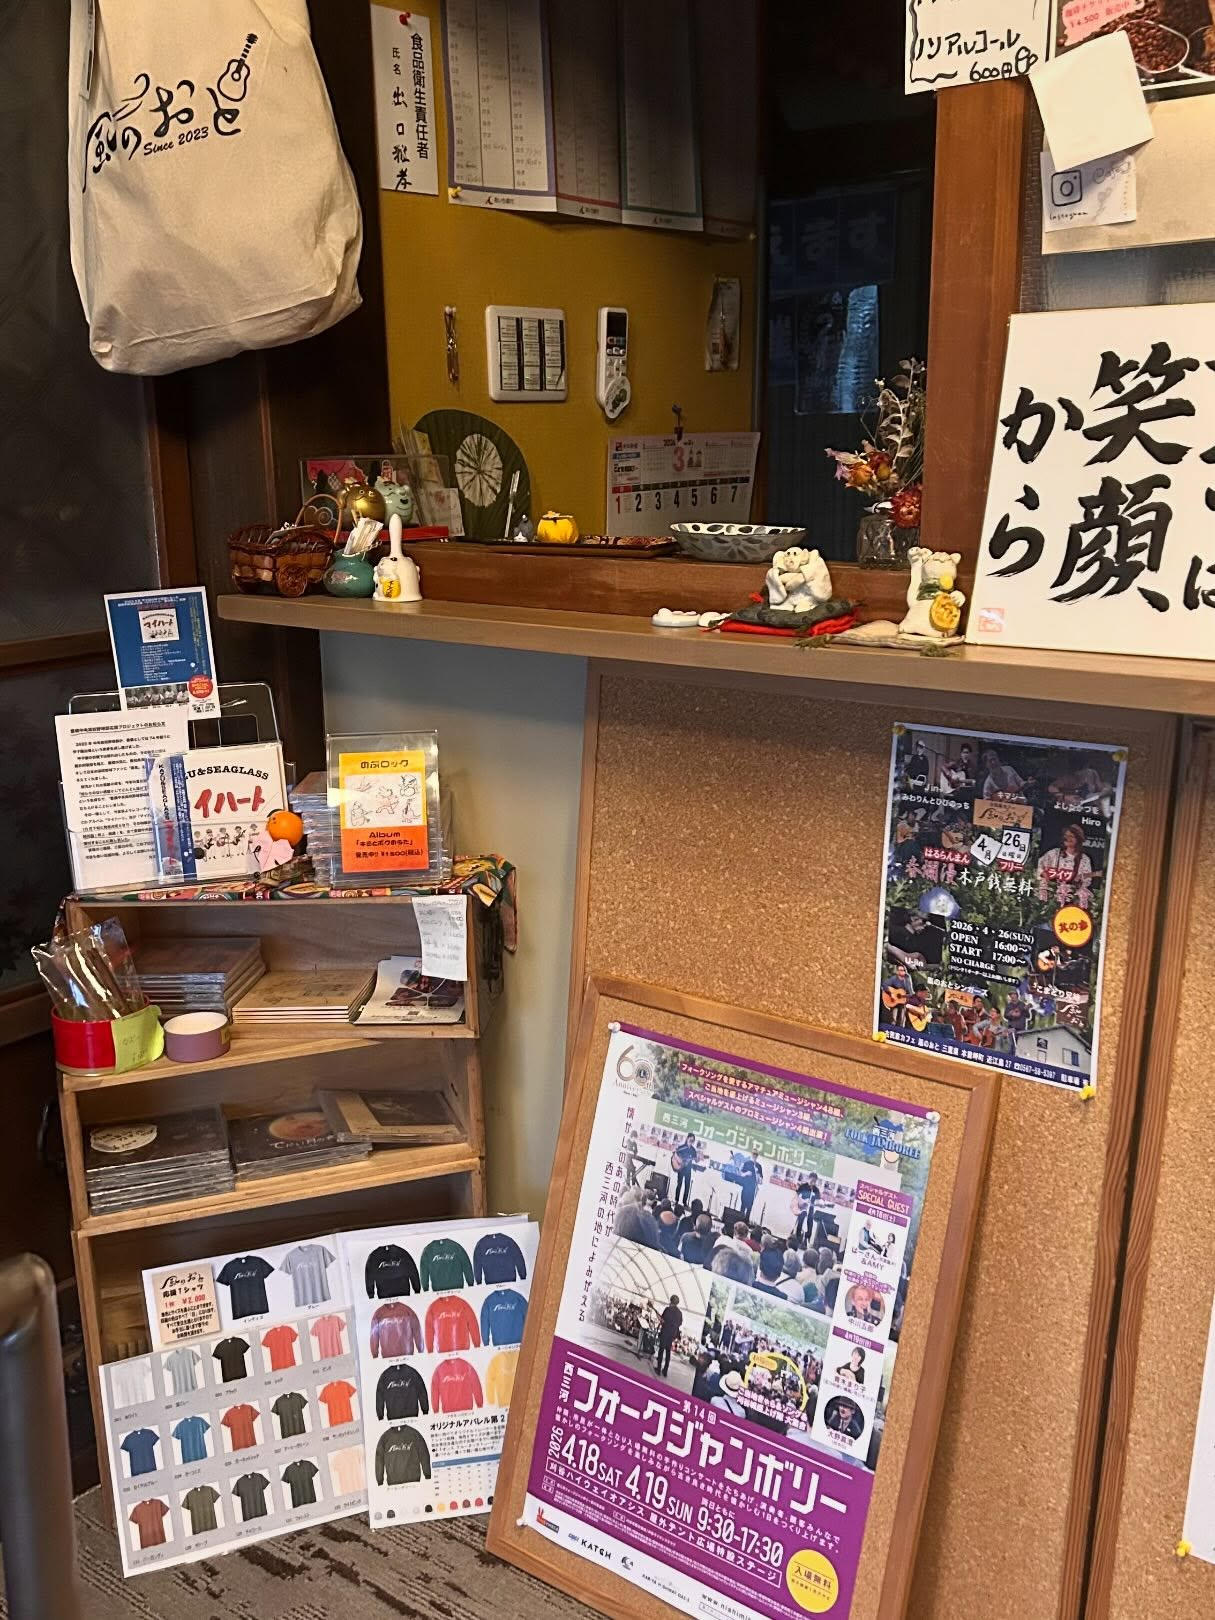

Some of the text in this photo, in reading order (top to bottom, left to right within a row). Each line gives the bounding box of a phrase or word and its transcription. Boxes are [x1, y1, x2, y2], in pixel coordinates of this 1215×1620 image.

[391, 47, 402, 75] 氏名
[969, 60, 1013, 82] 600円
[410, 32, 430, 160] 食品衛生責任者
[144, 126, 210, 156] Since 2023
[672, 446, 685, 472] 3
[986, 386, 1085, 578] から
[1048, 341, 1200, 612] 笑顔
[615, 485, 738, 514] 1 2 3 4 5 6 7
[185, 765, 269, 780] U&SEAGLASS
[360, 759, 409, 769] のぶロック
[1081, 816, 1102, 827] Hiro
[369, 831, 401, 839] Album
[924, 847, 970, 864] はるらんまん
[1000, 861, 1024, 871] フリー
[958, 867, 1035, 897] 木戸銭無料
[1048, 868, 1073, 880] ライヴ
[949, 943, 982, 957] START
[950, 931, 979, 945] OPEN
[904, 956, 924, 968] U-jin
[951, 955, 996, 971] NO CHARGE
[917, 1037, 940, 1051] 風のおと
[662, 1112, 818, 1168] 西三河 フォークジャンボリー
[845, 1127, 921, 1160] FOLK JAMBOREE
[857, 1189, 910, 1214] SPECIAL GUEST
[162, 1284, 205, 1298] 応援Tシャツ
[548, 1425, 564, 1459] 2026
[558, 1361, 575, 1403] 西三河
[573, 1366, 848, 1515] フォークジャンボリー
[549, 1462, 646, 1517] 刈谷ハイウェイオアシス
[561, 1434, 600, 1476] 4.18
[597, 1462, 623, 1489] SAT
[624, 1465, 669, 1510] 4.19
[666, 1496, 694, 1524] SUN
[580, 1538, 613, 1561] KATCH
[696, 1506, 785, 1568] 9:30-17:30
[794, 1565, 832, 1590] 入場無料
